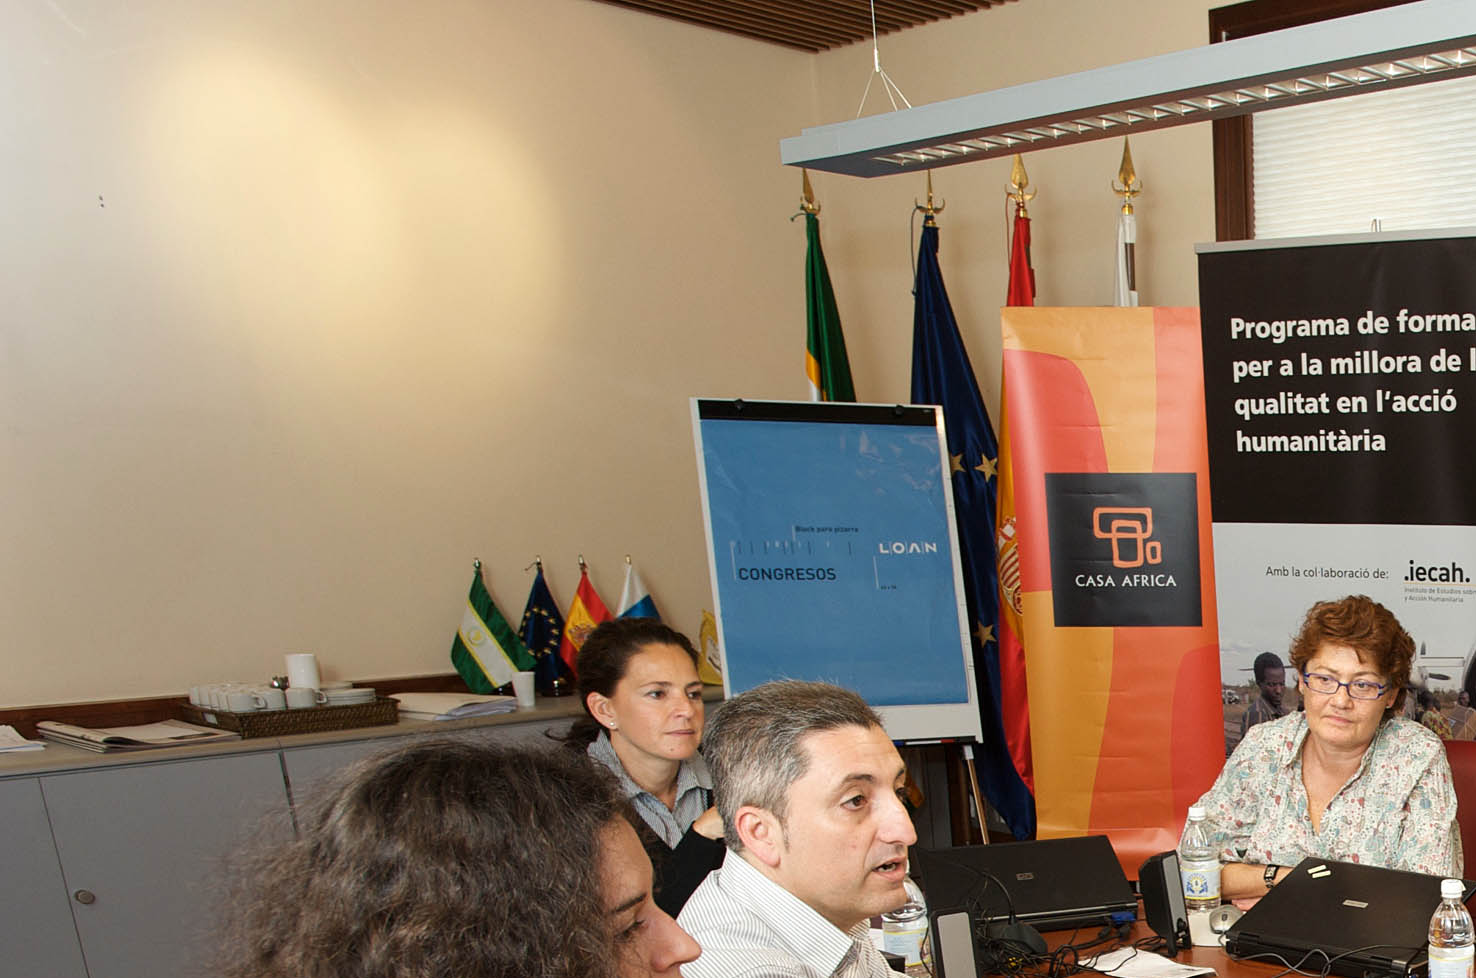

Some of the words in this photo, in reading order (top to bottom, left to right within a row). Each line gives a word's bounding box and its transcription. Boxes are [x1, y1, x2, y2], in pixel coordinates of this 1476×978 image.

[1231, 315, 1349, 344] Programa
[1357, 310, 1389, 334] de
[1233, 359, 1272, 383] per
[1280, 362, 1293, 376] a
[1301, 353, 1323, 375] la
[1330, 350, 1421, 375] millora
[1430, 349, 1461, 372] de
[1234, 392, 1329, 420] qualitat
[1336, 395, 1368, 413] en
[1236, 429, 1386, 452] humanitària
[738, 567, 837, 581] CONGRESOS
[1075, 574, 1116, 588] CASA
[1122, 574, 1177, 588] AFRICA
[1266, 567, 1289, 577] Amb
[1291, 566, 1301, 577] la
[1372, 568, 1389, 579] de:
[1404, 560, 1470, 583] .iecah.
